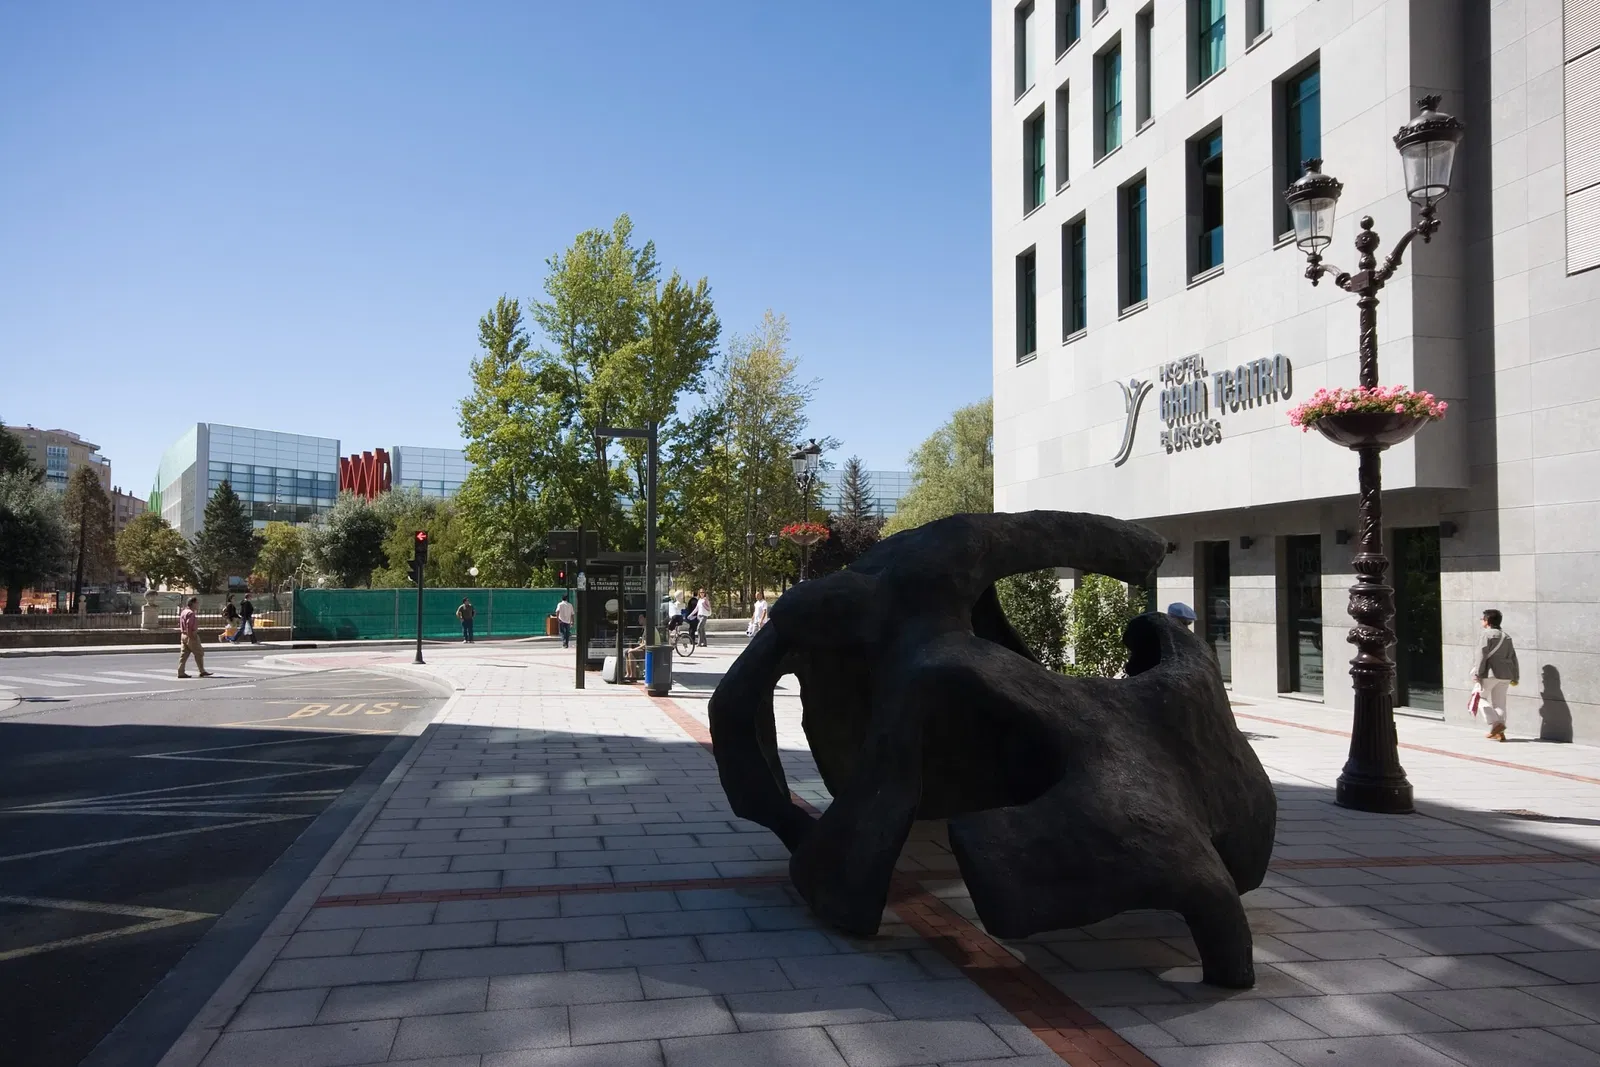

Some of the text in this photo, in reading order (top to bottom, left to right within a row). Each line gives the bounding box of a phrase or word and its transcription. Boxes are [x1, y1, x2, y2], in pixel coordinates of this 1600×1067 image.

[1160, 353, 1205, 385] HOTEL
[1160, 354, 1289, 424] GRAN TEATRO
[1160, 419, 1219, 450] BURGOS
[287, 702, 400, 719] BUS
